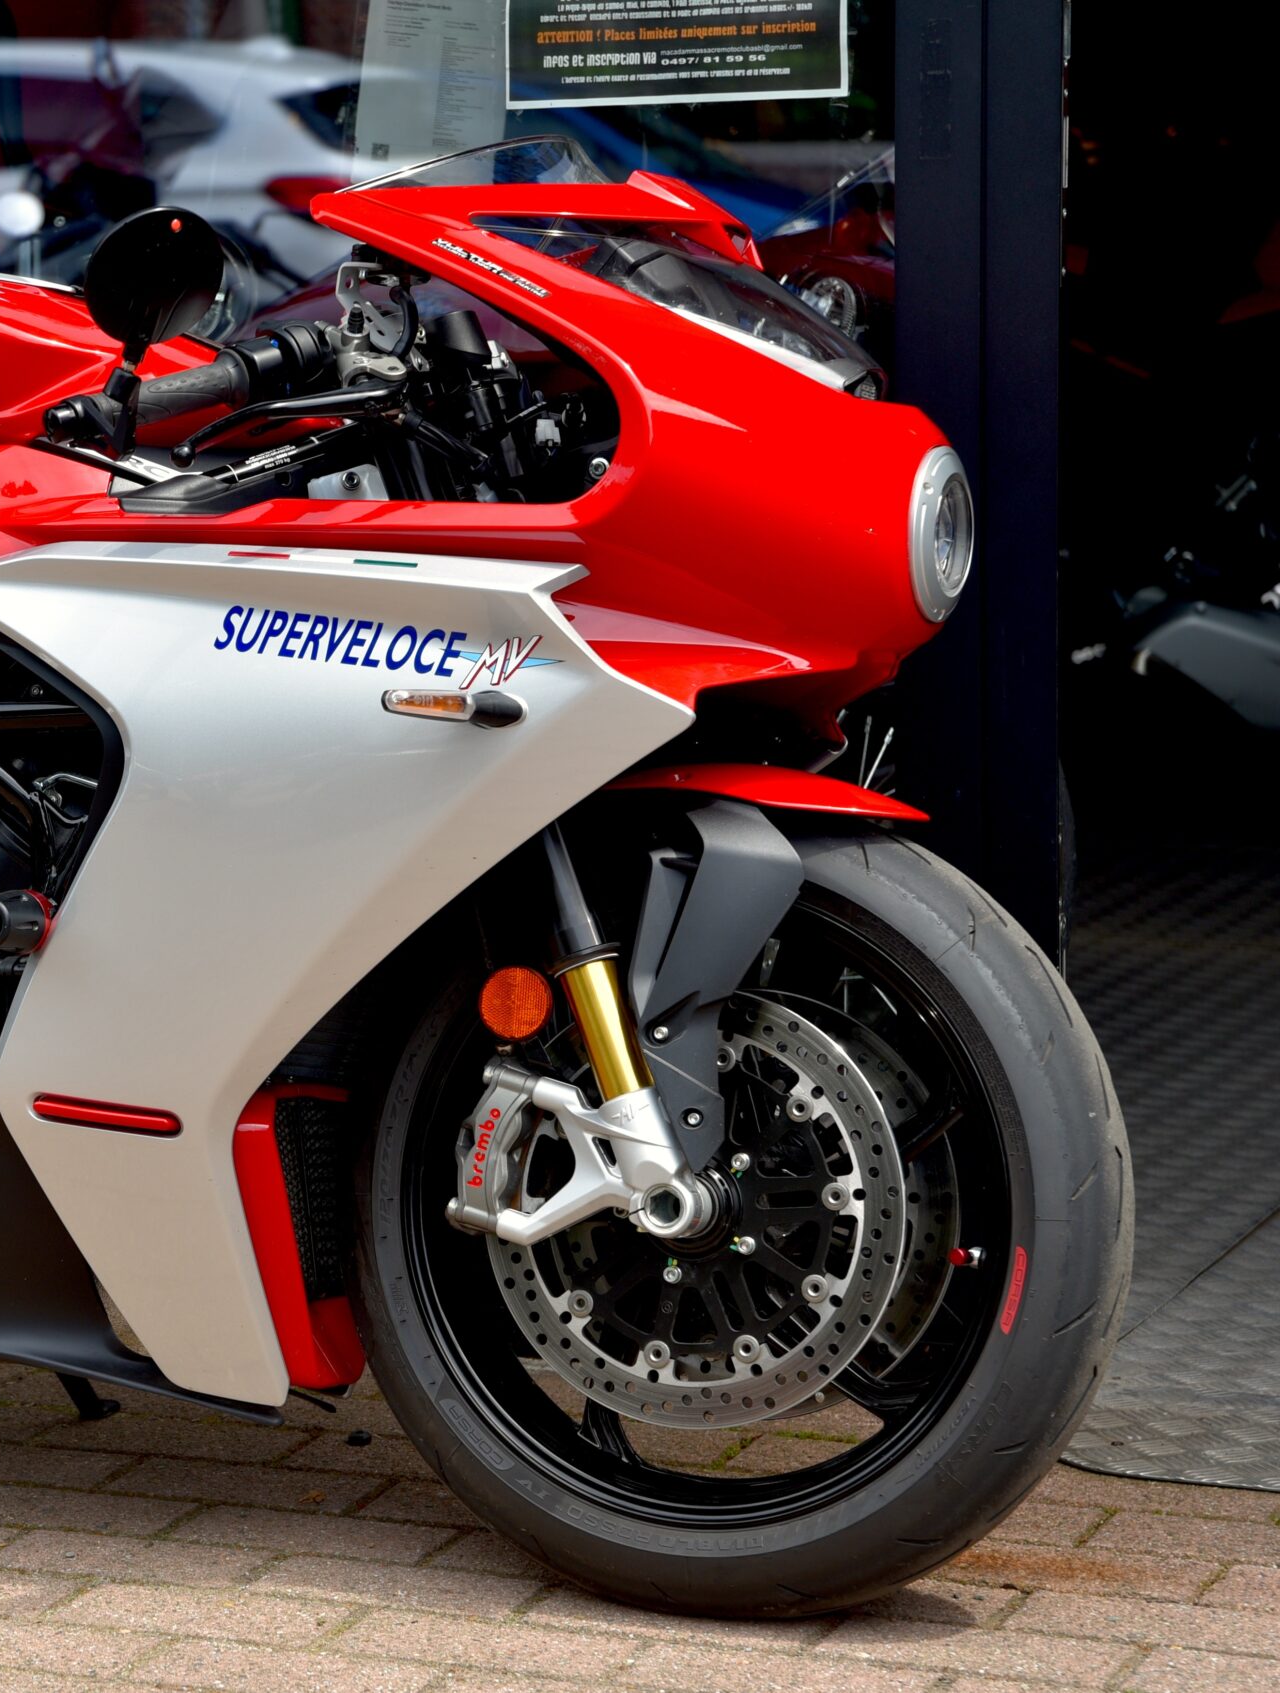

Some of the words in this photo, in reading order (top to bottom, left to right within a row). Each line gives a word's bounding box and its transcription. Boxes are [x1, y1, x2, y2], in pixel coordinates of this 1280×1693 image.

[604, 29, 635, 41] Places
[639, 26, 677, 40] limitées
[681, 25, 737, 39] uniquement
[741, 24, 758, 35] sur
[762, 20, 816, 34] inscription
[572, 55, 583, 67] et
[586, 52, 640, 67] inscription
[214, 605, 467, 677] SUPERVELOCE
[459, 635, 544, 690] MV
[467, 1108, 501, 1187] brembo
[1002, 1254, 1025, 1325] CORSA
[448, 1403, 504, 1467] CORSA
[567, 1504, 651, 1543] ROSSO
[659, 1533, 765, 1552] DIABLO
